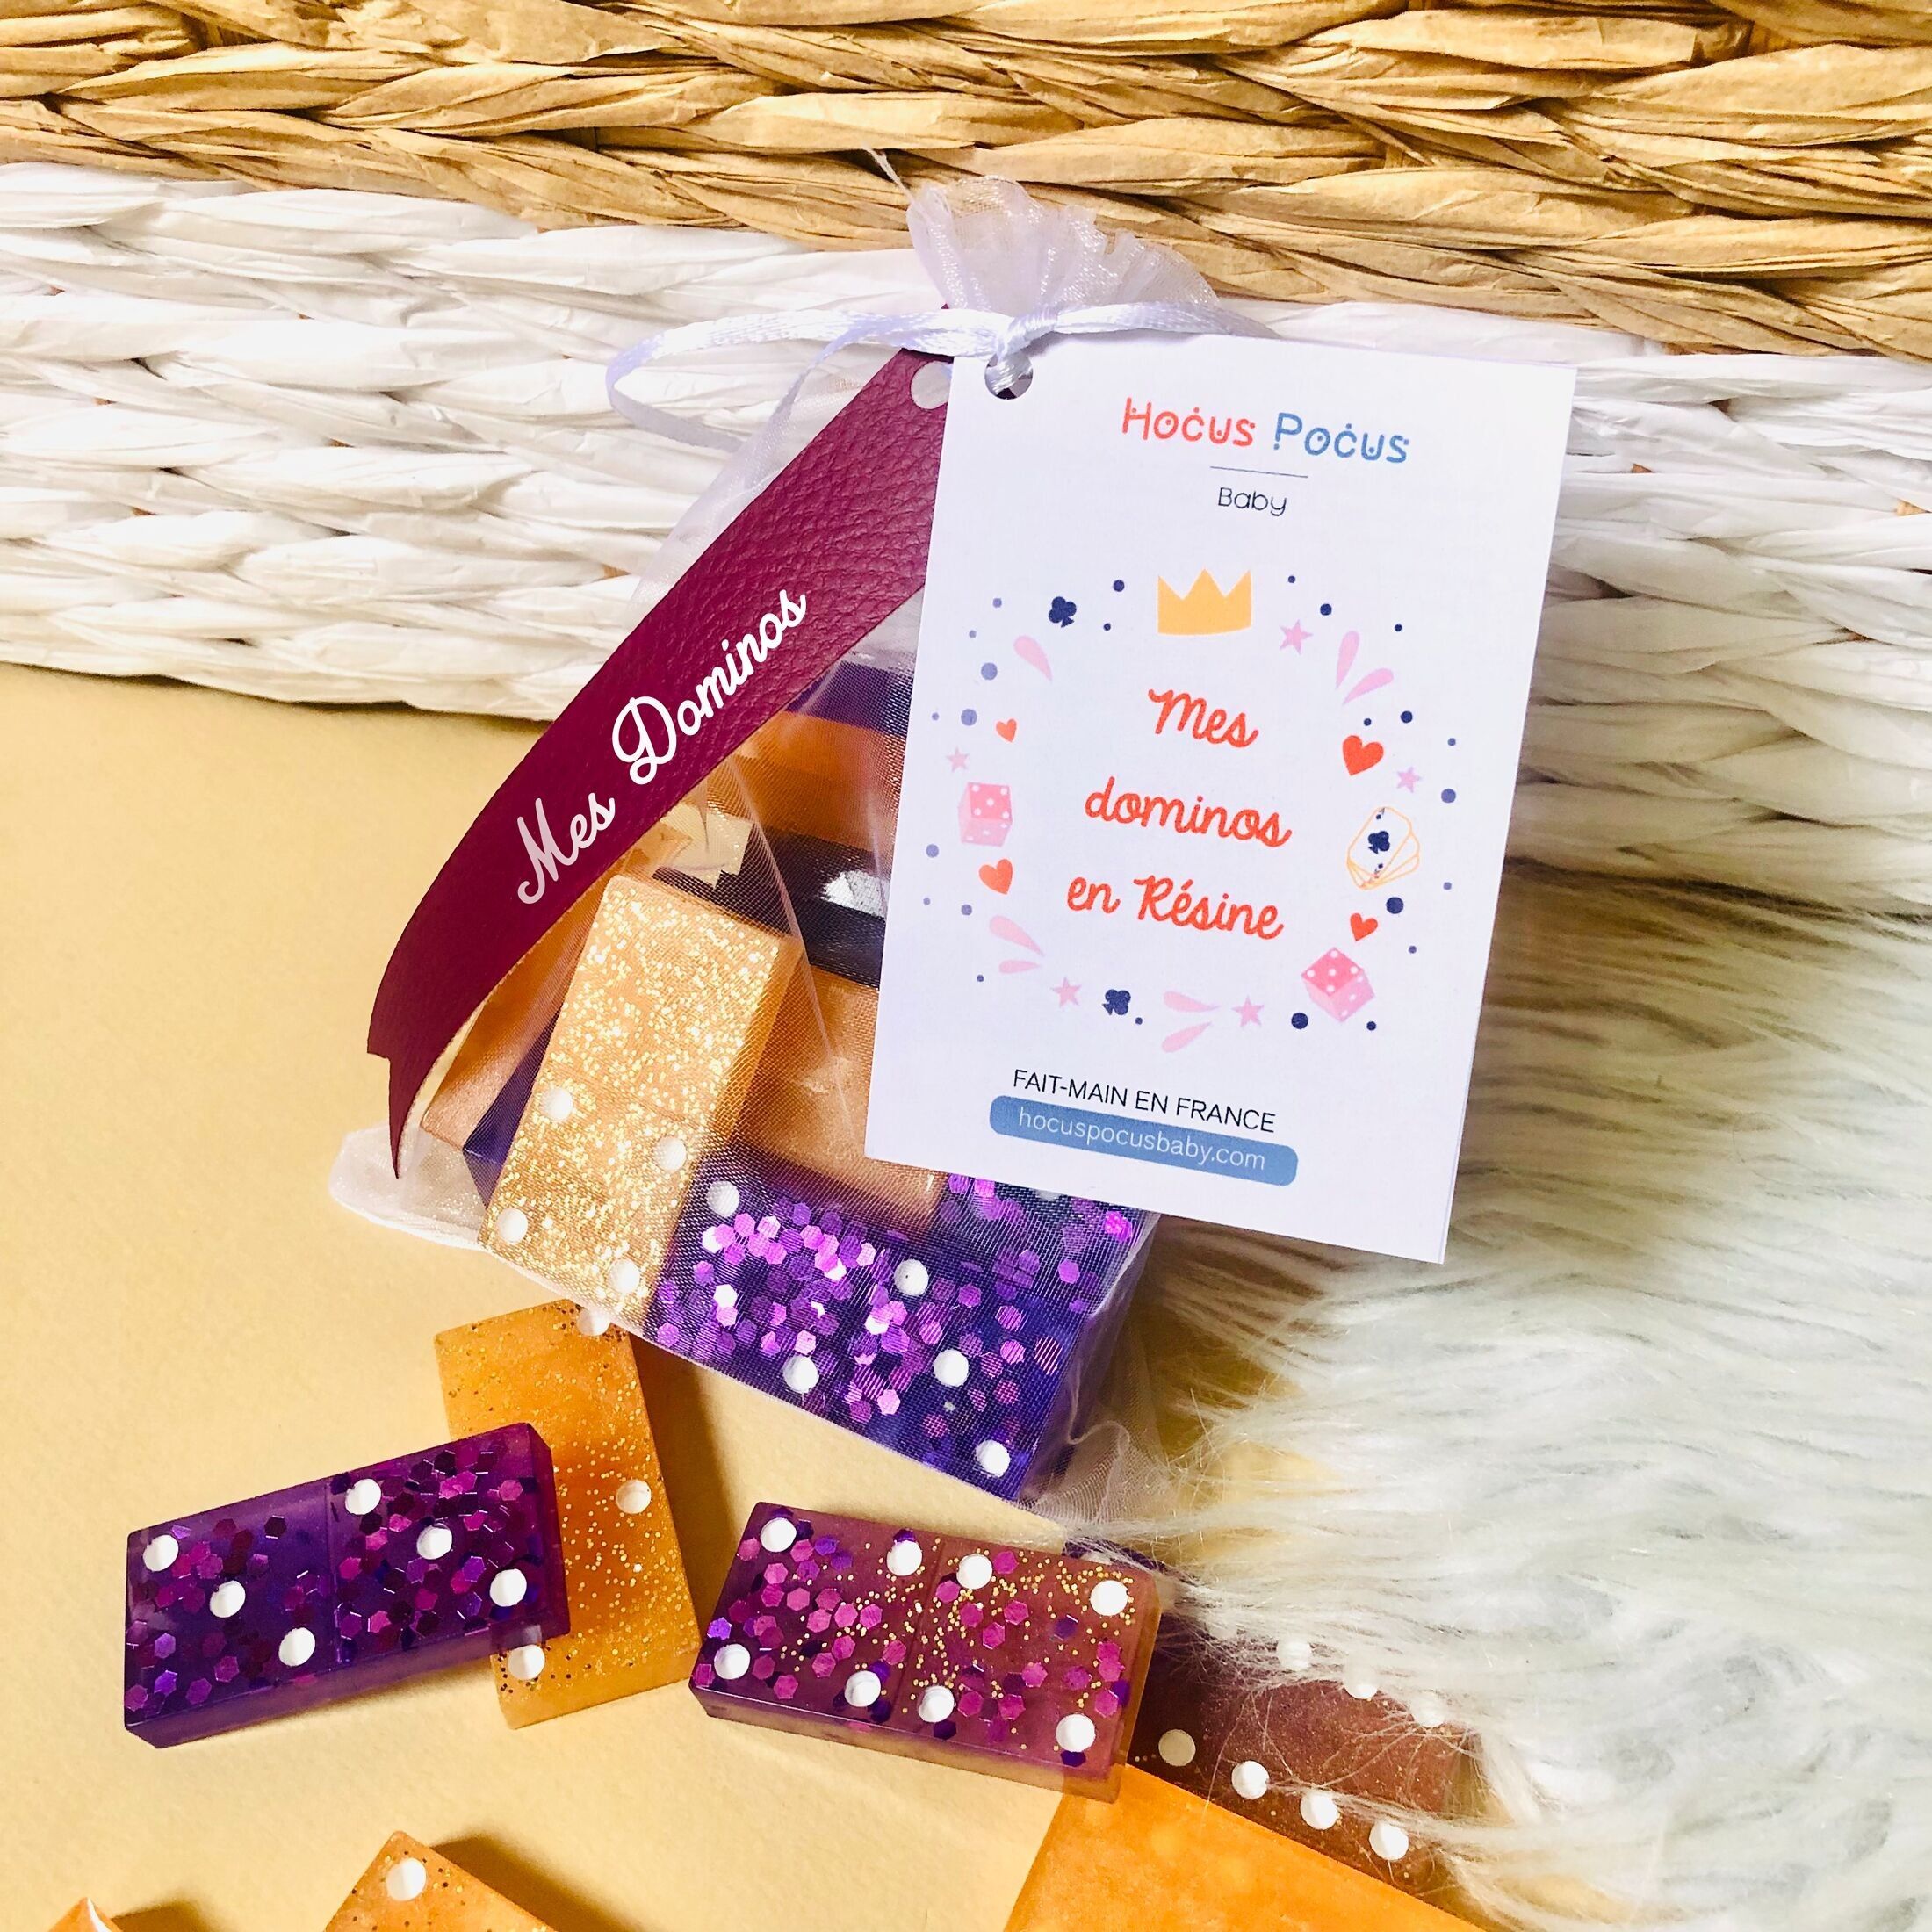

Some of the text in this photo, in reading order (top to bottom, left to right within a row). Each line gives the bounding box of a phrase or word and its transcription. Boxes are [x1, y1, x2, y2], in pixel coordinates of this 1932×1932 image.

[1121, 398, 1409, 464] Hocus Pocus
[1217, 487, 1287, 517] Baby
[516, 588, 808, 905] Mes Dominos
[1148, 689, 1259, 749] Mes
[1085, 776, 1293, 848] dominos
[1067, 875, 1285, 941] en Résine
[1013, 1069, 1276, 1134] FAIT-MAIN EN FRANCE
[1019, 1107, 1265, 1171] hocuspocusbaby.com
